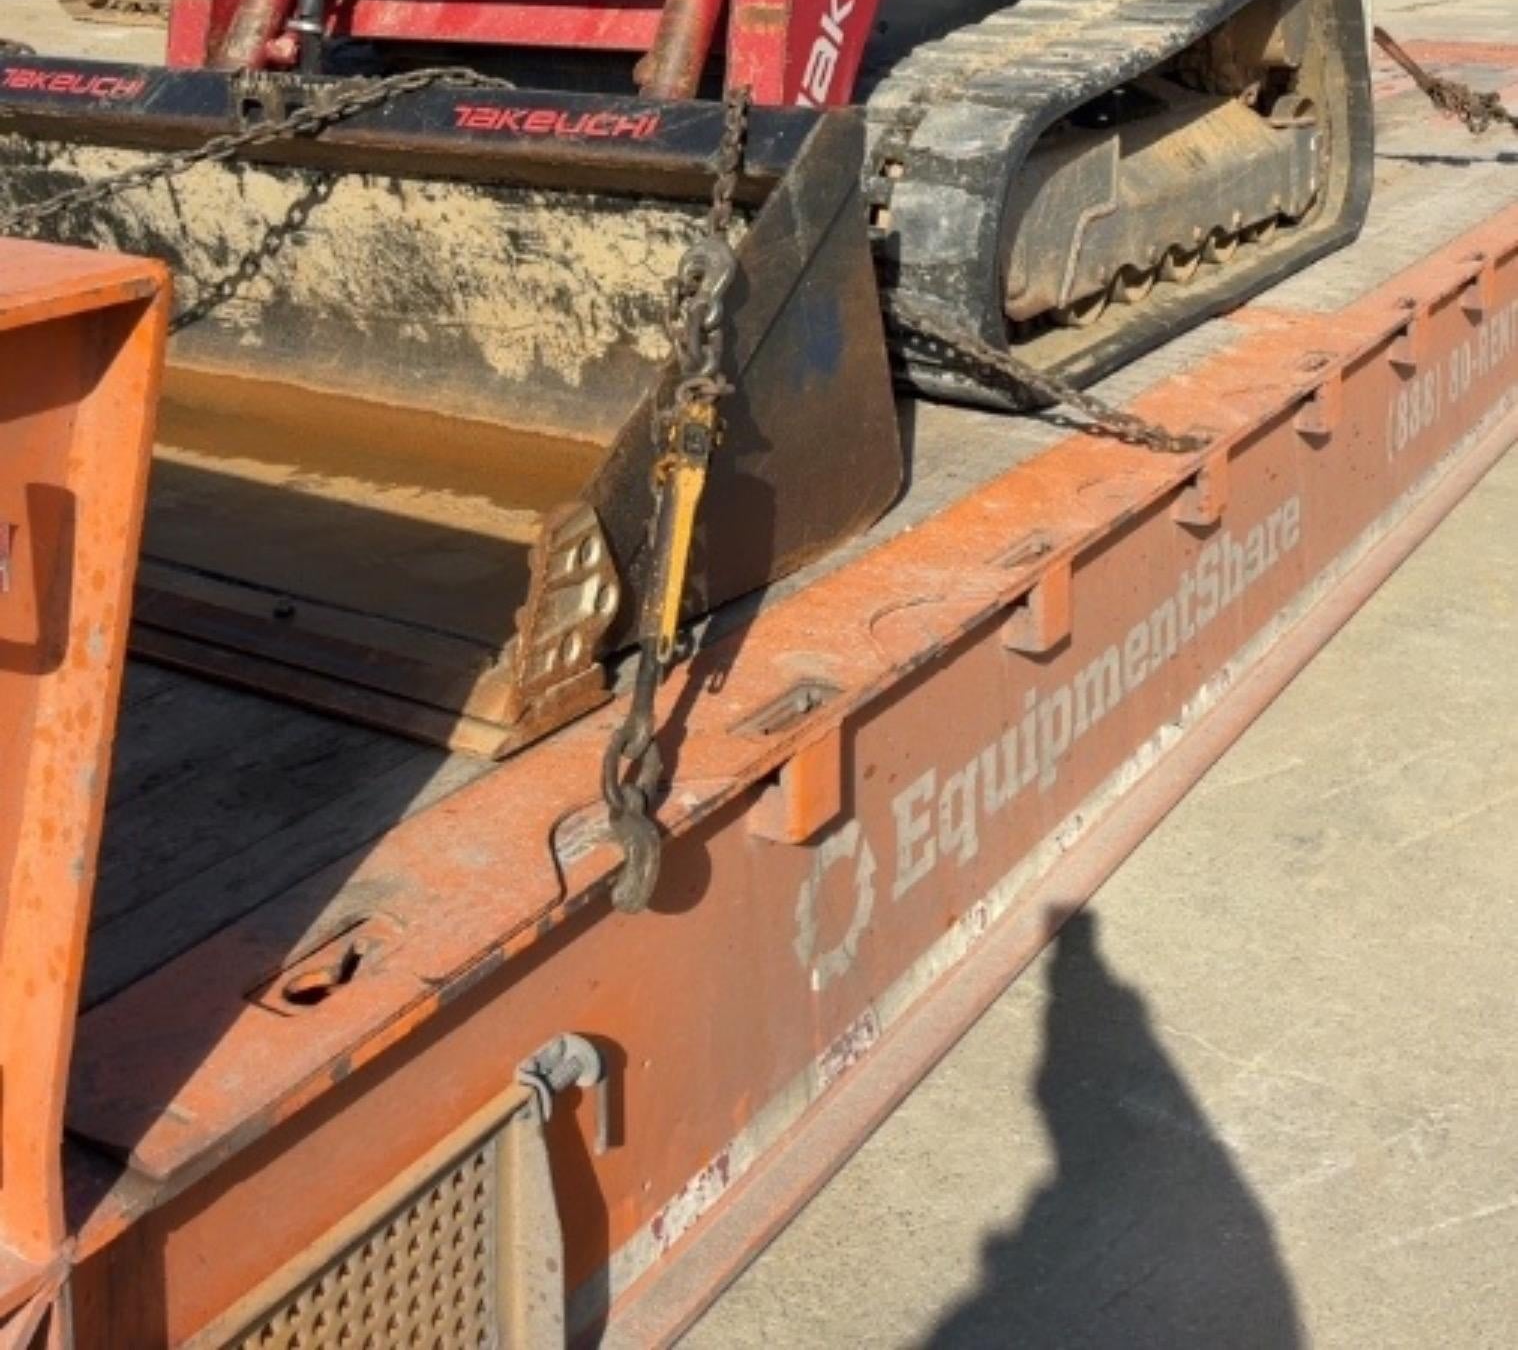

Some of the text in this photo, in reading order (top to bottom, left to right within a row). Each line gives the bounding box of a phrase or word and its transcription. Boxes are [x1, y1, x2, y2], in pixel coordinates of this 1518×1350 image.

[3, 67, 146, 97] TAKEUCHI
[454, 106, 661, 139] TAKEUCHI
[891, 496, 1300, 901] EquipmentShare
